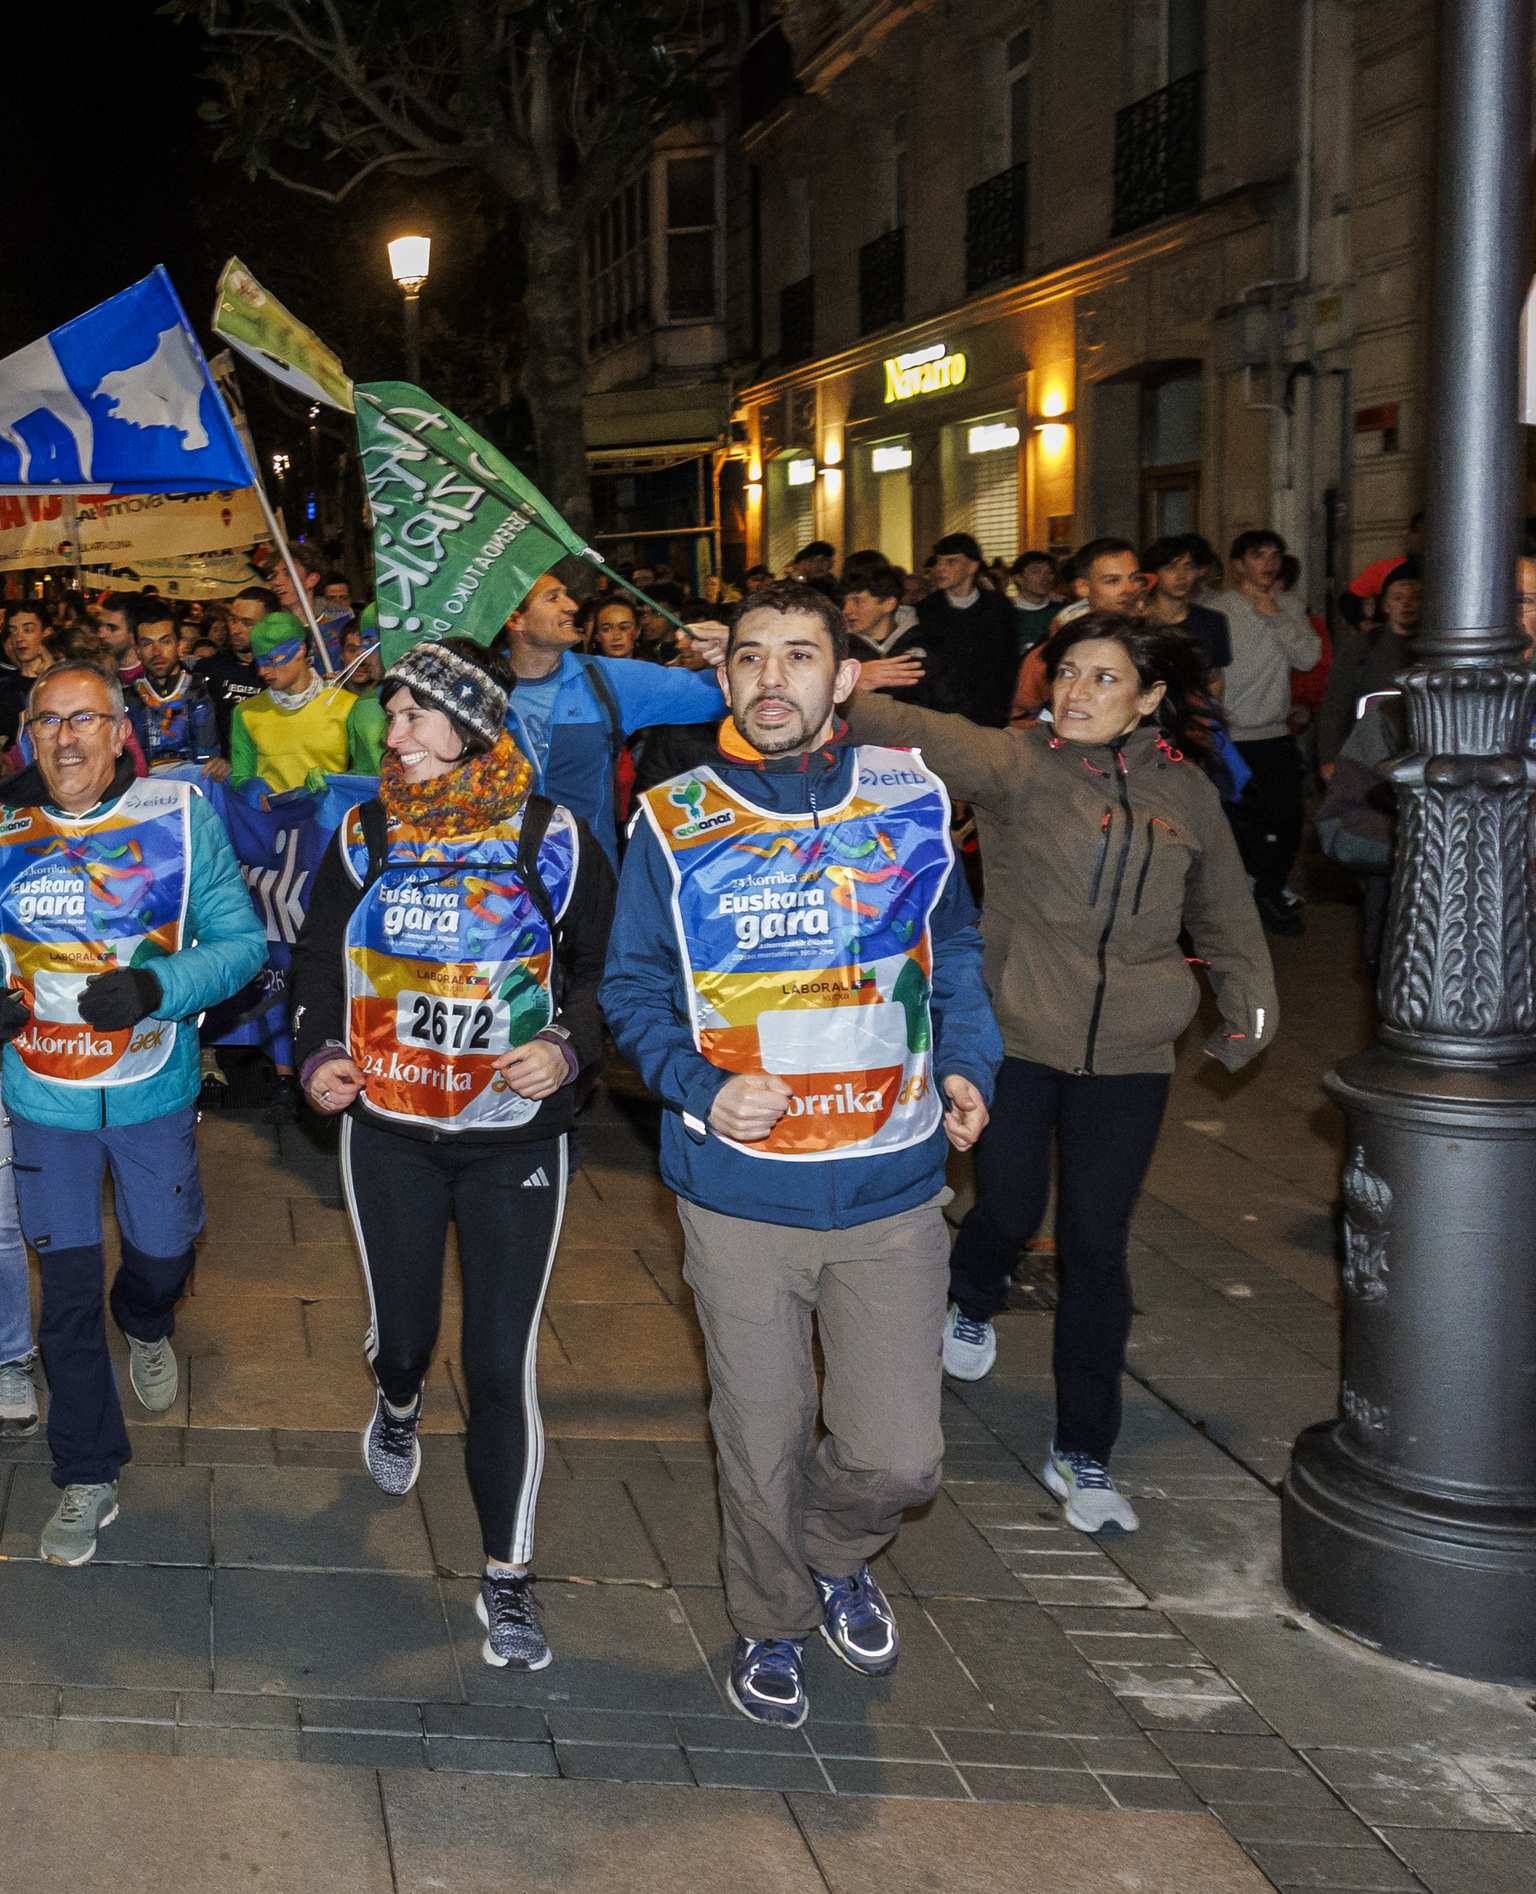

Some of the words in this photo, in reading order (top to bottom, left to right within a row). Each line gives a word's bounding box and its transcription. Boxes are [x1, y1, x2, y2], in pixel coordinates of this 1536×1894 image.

[883, 353, 966, 403] Navarro
[881, 769, 926, 787] eitb
[143, 795, 178, 807] eitb
[10, 876, 84, 894] Euskara
[379, 885, 460, 908] Euskara
[19, 895, 86, 923] gara
[719, 887, 825, 914] Euskara
[384, 906, 460, 936] gara
[735, 908, 829, 950] gara
[49, 952, 96, 961] LABORAL
[417, 970, 465, 984] LABORAL
[782, 982, 849, 995] LABORAL
[412, 996, 494, 1049] 2672
[16, 1026, 114, 1057] 4.korrika
[129, 1021, 167, 1054] aek
[363, 1052, 472, 1092] 24.korrika
[898, 1062, 930, 1105] aek
[788, 1082, 884, 1117] orrika
